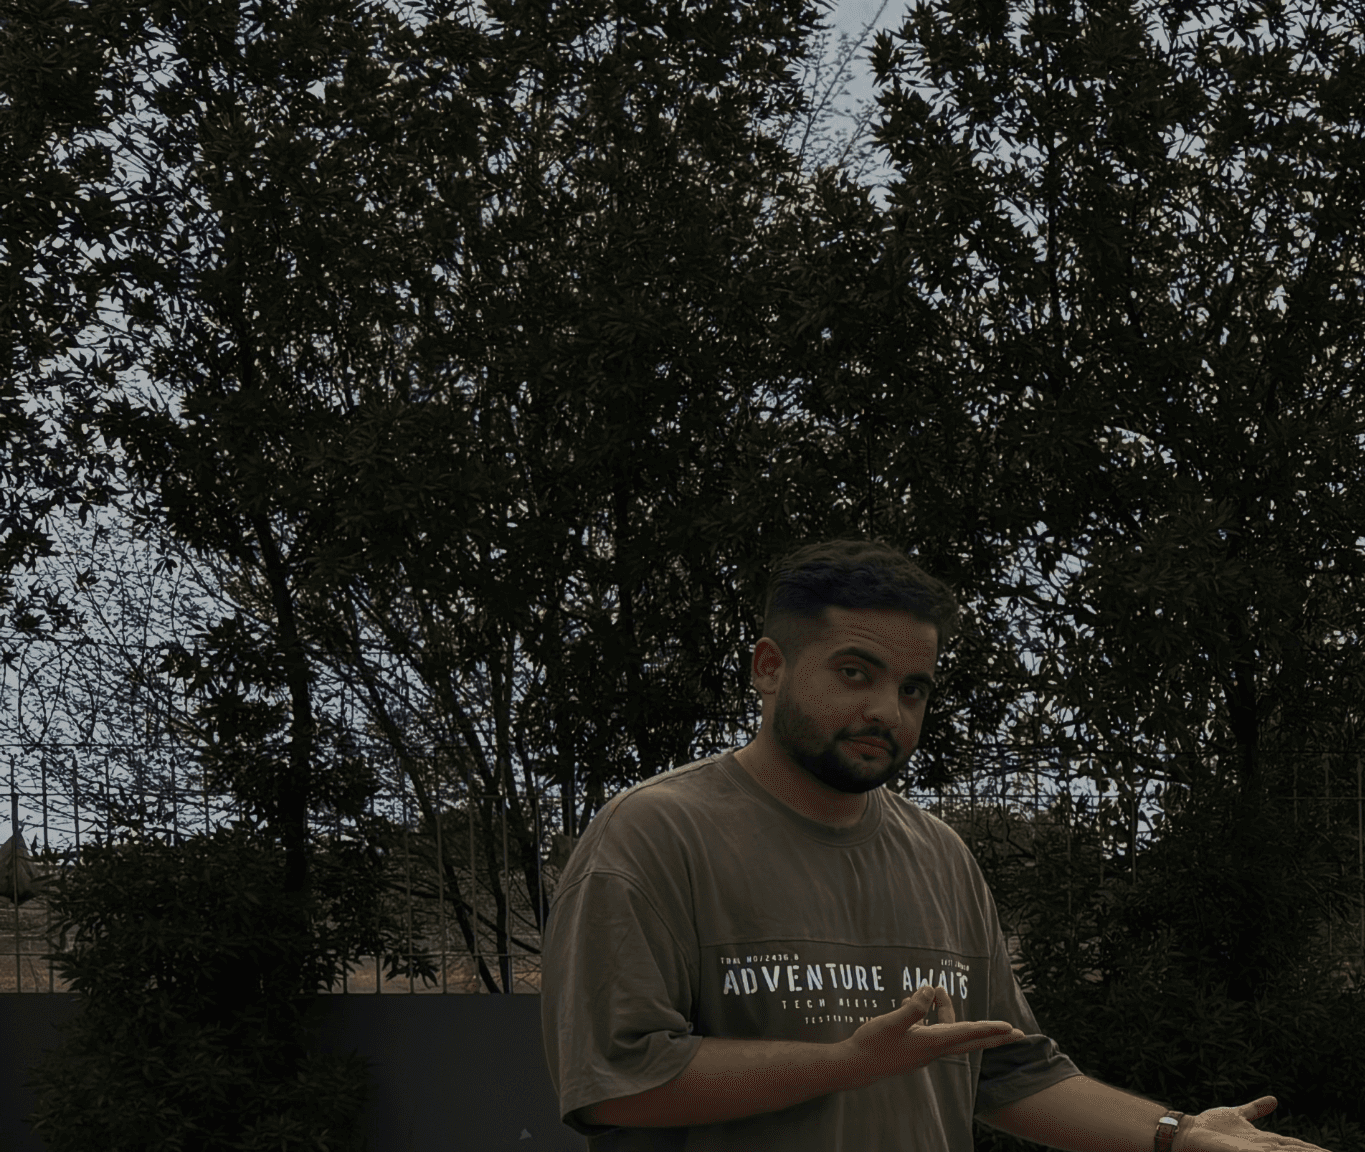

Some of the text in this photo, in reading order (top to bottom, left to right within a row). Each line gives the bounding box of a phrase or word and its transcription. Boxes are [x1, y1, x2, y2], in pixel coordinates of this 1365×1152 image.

[723, 963, 969, 1000] ADVENTURE AWAITS
[782, 998, 826, 1010] TECH
